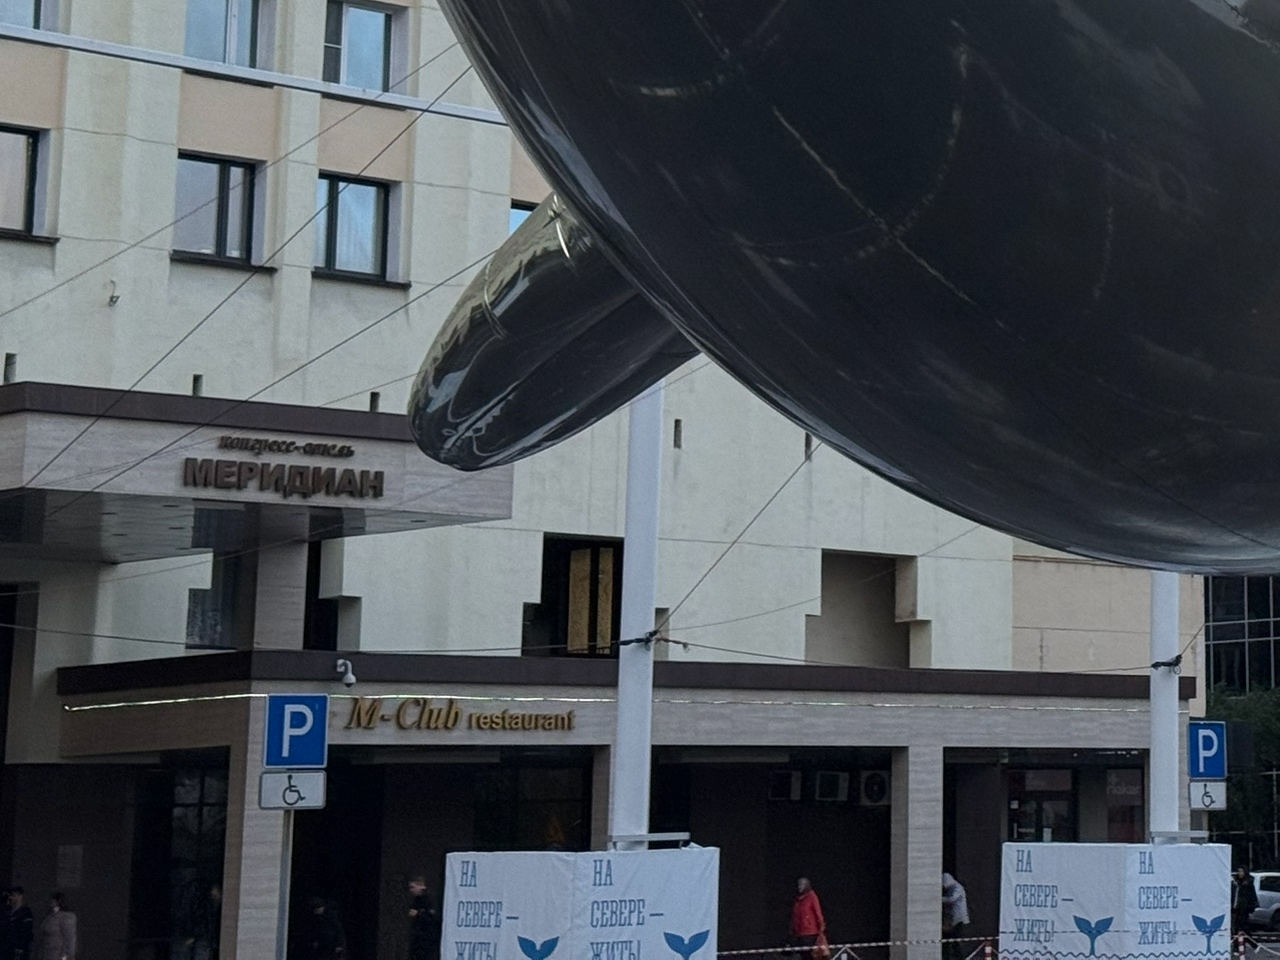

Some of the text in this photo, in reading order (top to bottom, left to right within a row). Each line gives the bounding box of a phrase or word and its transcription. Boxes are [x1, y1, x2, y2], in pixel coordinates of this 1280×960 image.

[183, 457, 385, 499] МЕРИДИАН
[345, 696, 463, 731] M-Club
[467, 708, 577, 732] restaurant
[459, 861, 478, 888] НА
[592, 859, 613, 887] НА
[1016, 850, 1032, 873] НА
[1138, 851, 1155, 874] НА
[1014, 884, 1058, 908] СЕВЕРЕ
[1138, 886, 1178, 910] СЕВЕРЕ
[455, 901, 503, 928] СЕВЕРЕ
[590, 899, 645, 928] СЕВЕРЕ
